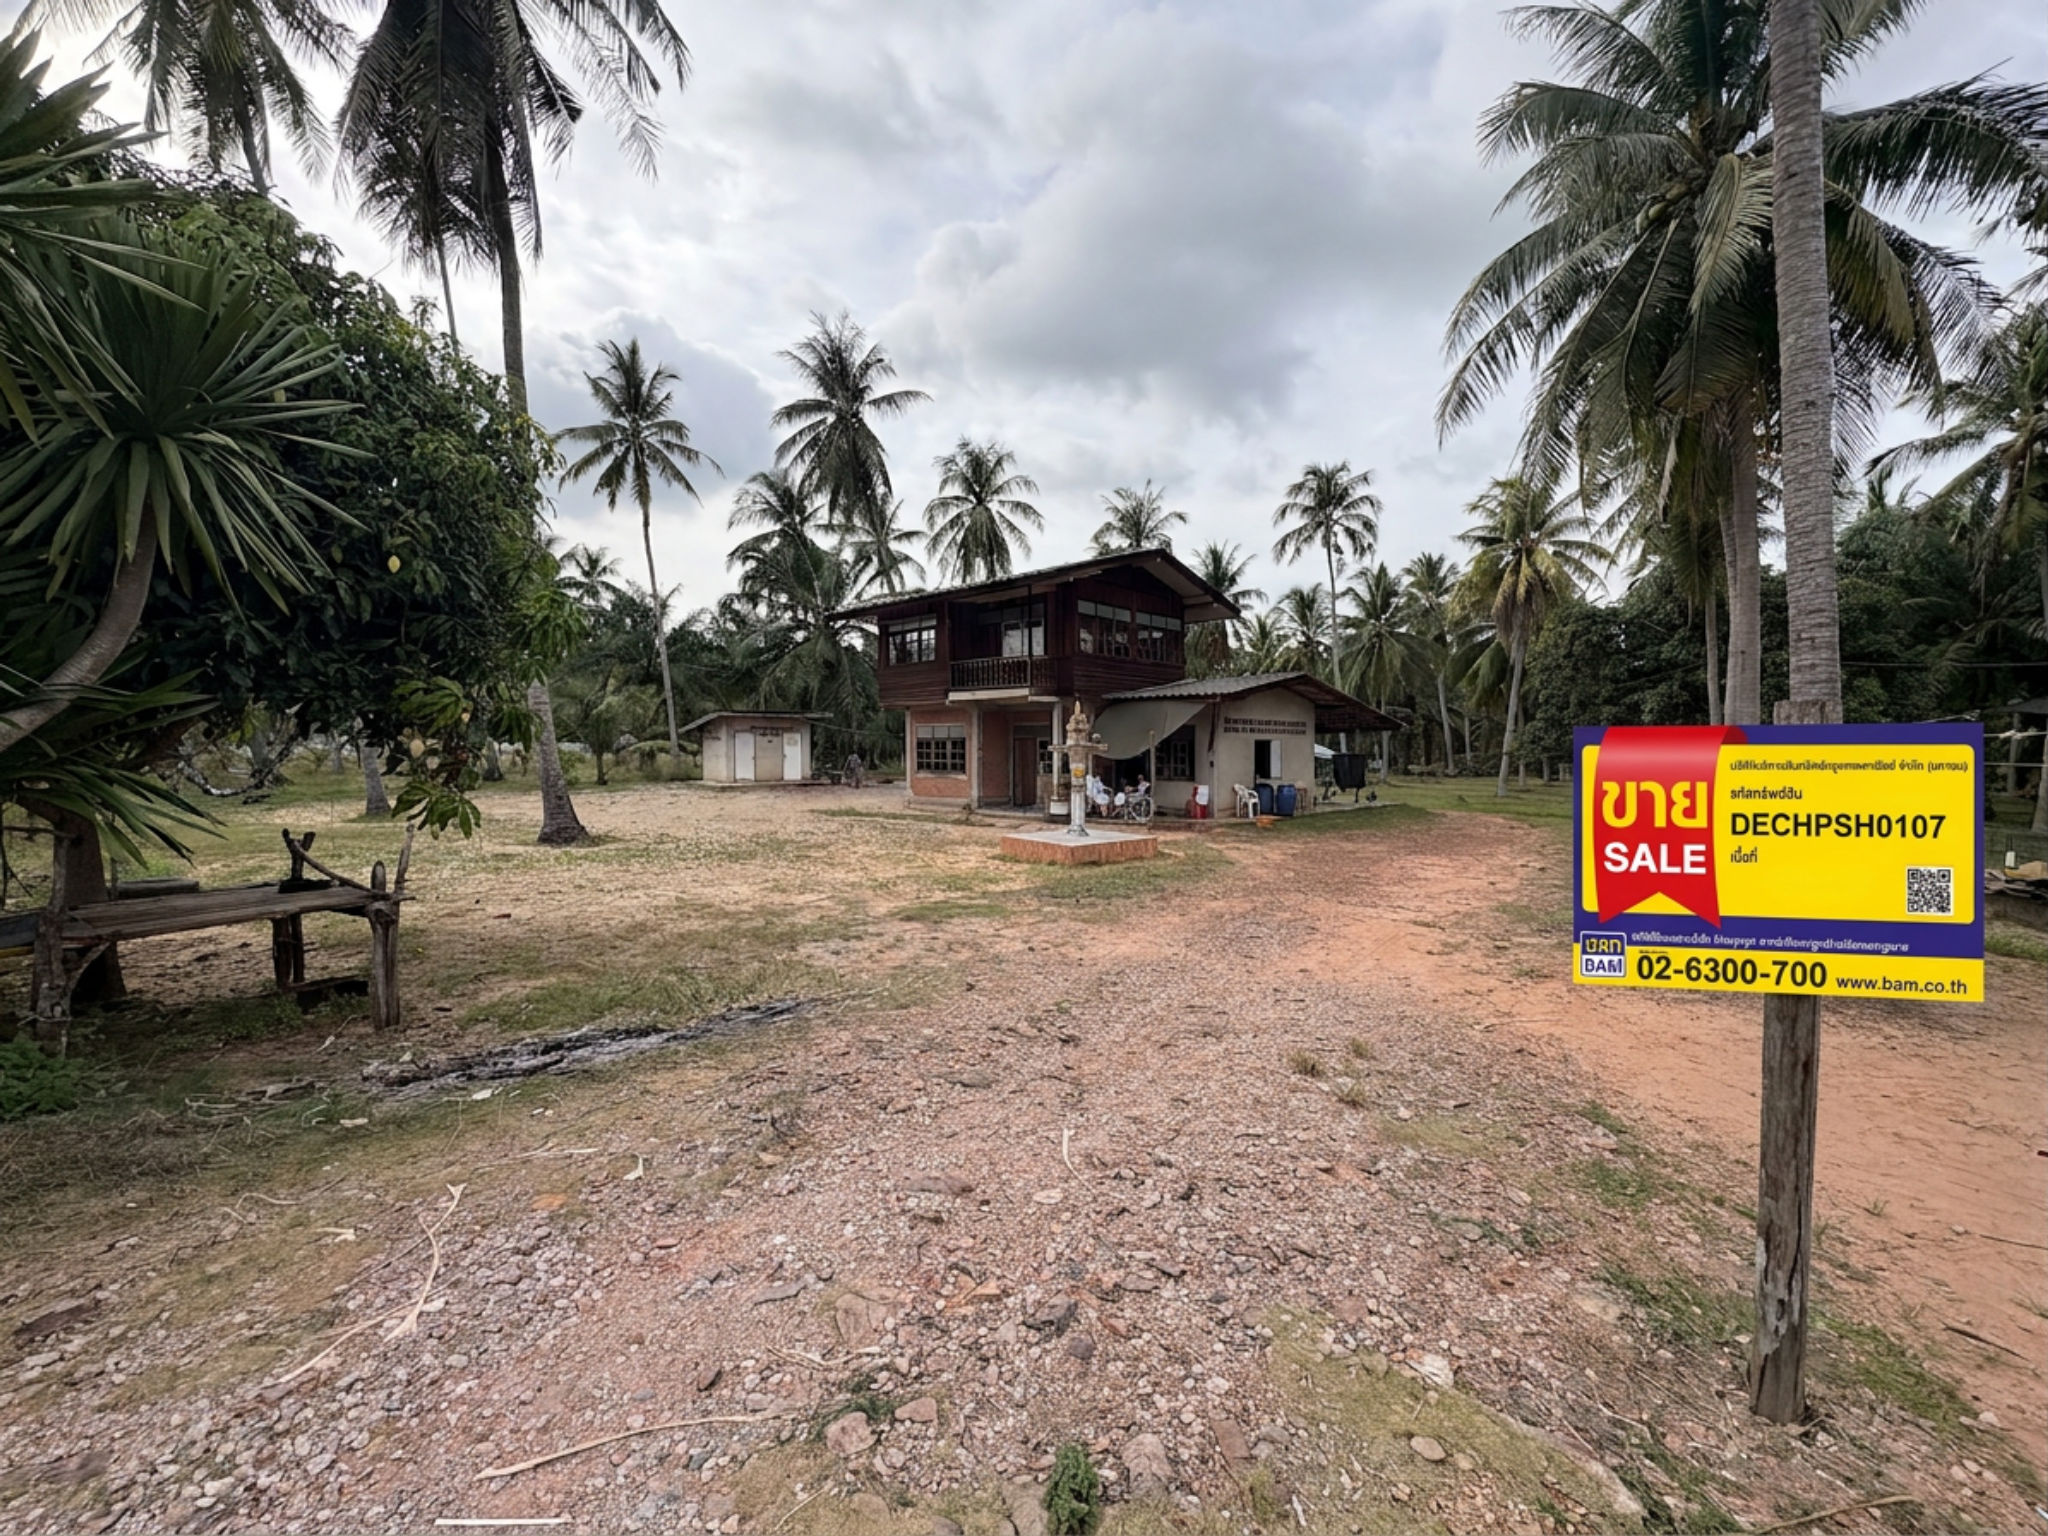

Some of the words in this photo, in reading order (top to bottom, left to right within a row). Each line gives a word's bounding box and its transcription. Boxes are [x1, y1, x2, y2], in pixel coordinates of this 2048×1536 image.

[1602, 780, 1708, 829] ขาย
[1730, 812, 1946, 839] DECHPSH0107
[1604, 842, 1707, 875] SALE
[1585, 958, 1622, 974] BAM
[1637, 954, 1828, 989] 02-6300-700
[1837, 974, 1968, 995] www.bam.co.th
